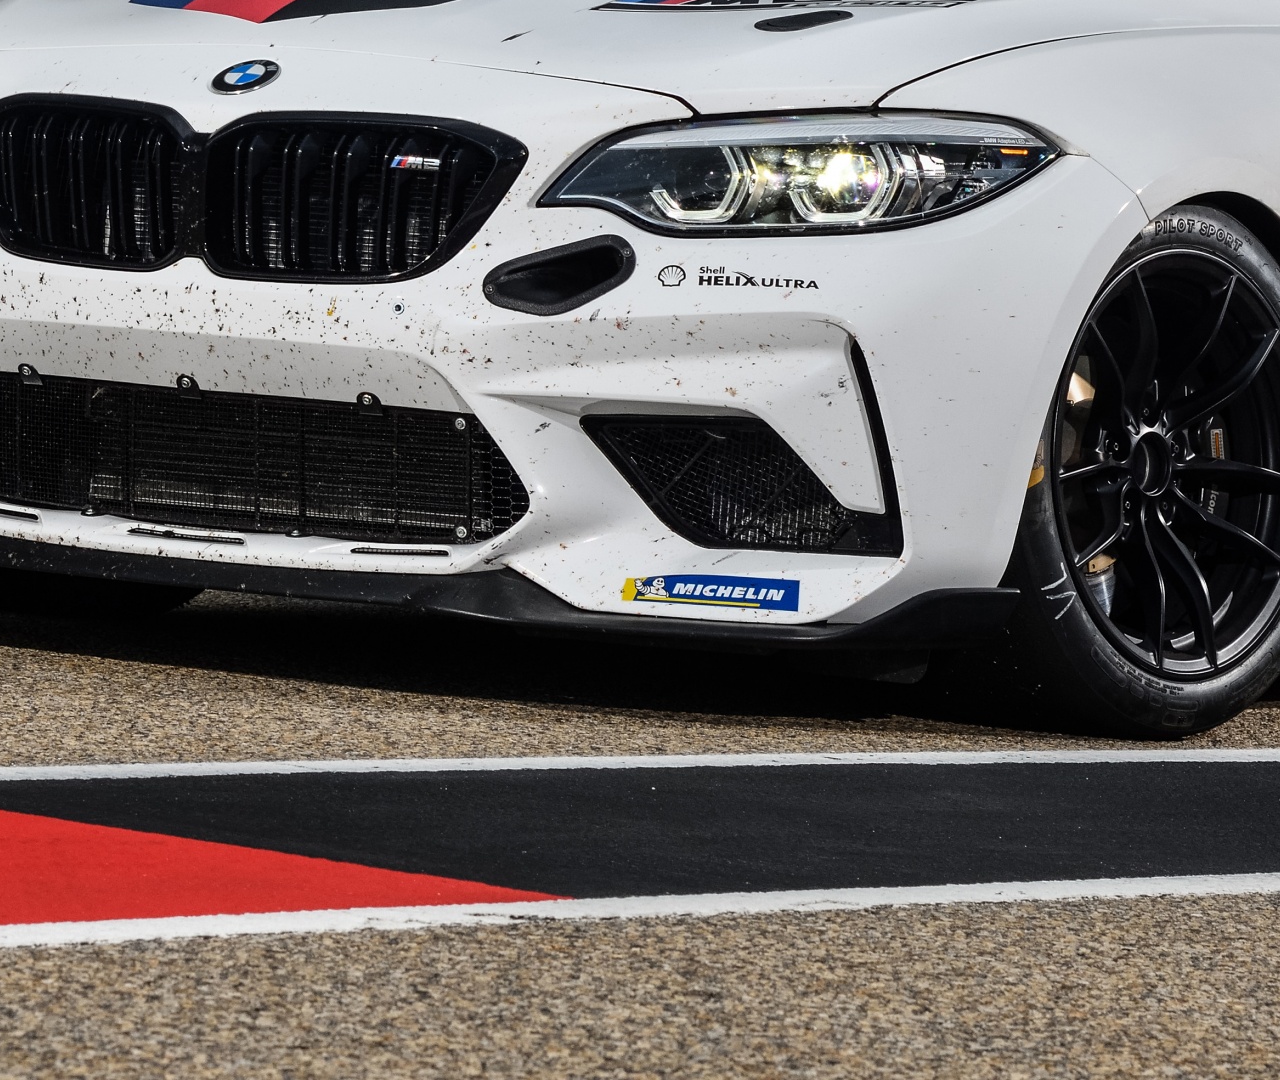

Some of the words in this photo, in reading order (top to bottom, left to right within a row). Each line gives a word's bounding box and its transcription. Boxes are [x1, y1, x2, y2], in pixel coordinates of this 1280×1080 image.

[1154, 218, 1196, 236] PILOT
[1199, 221, 1243, 252] SPORT
[699, 266, 725, 274] Shell
[698, 272, 758, 286] HELIX
[761, 278, 819, 289] ULTRA
[672, 583, 785, 601] MICHELIN
